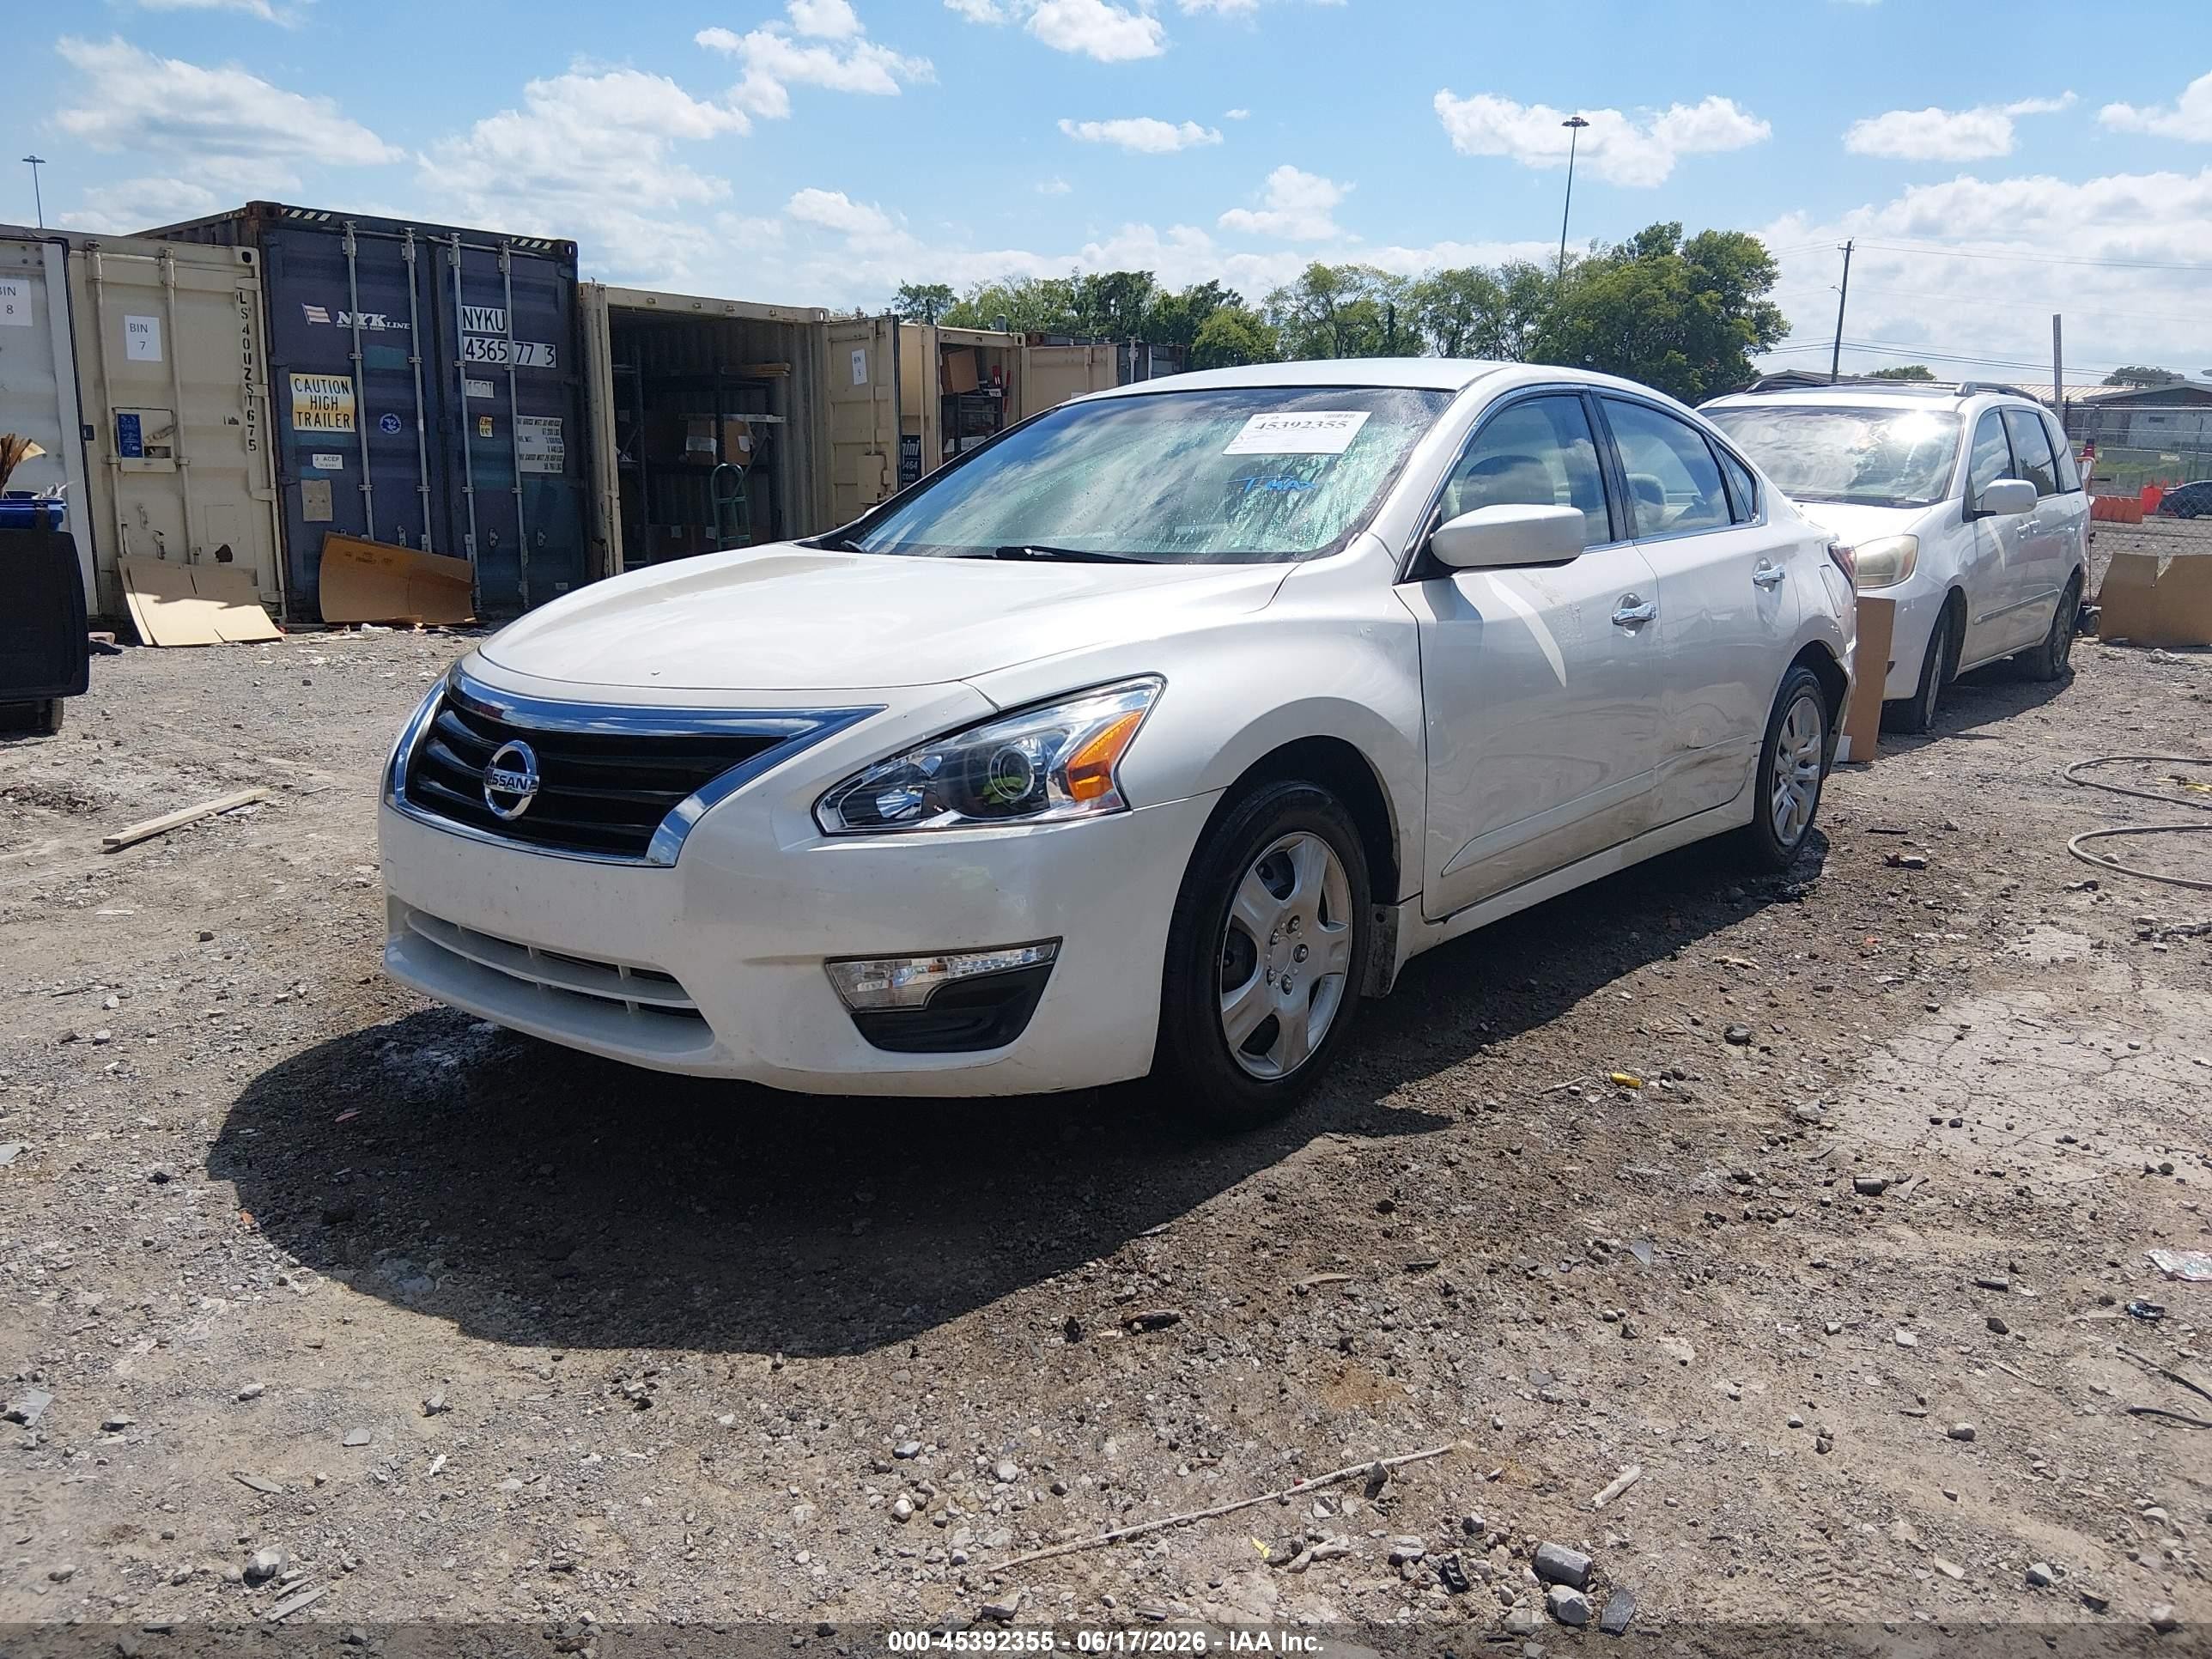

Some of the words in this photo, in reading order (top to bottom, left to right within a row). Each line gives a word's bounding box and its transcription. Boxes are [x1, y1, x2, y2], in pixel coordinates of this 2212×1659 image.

[7, 305, 14, 315] 8
[337, 311, 386, 327] NYK
[462, 307, 506, 331] NYKU
[130, 323, 148, 333] BIN
[138, 341, 146, 351] 7
[544, 345, 555, 366] 3
[294, 378, 350, 395] CAUTION
[309, 395, 338, 411] HIGH
[296, 411, 350, 428] TRAILER
[1255, 421, 1349, 430] 45392355
[486, 769, 528, 790] NISSAN
